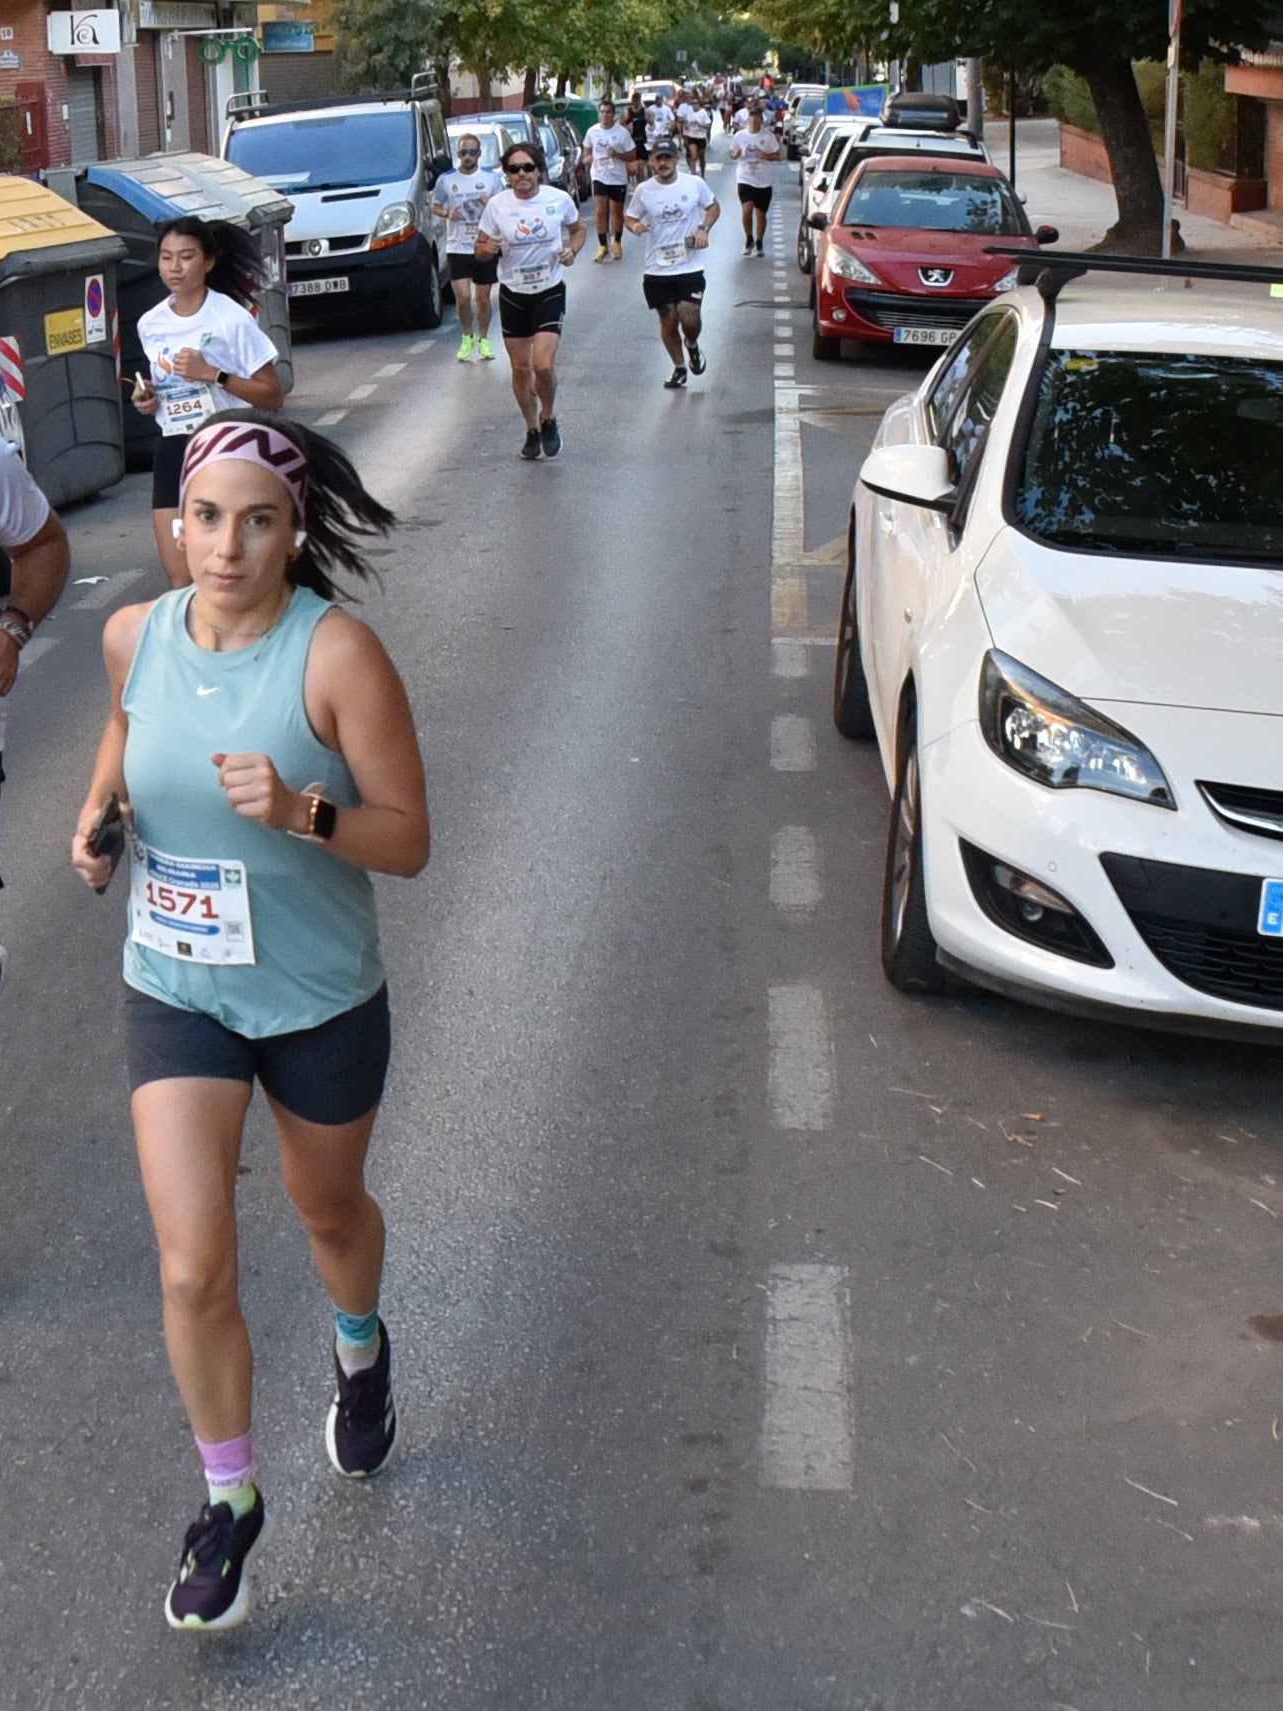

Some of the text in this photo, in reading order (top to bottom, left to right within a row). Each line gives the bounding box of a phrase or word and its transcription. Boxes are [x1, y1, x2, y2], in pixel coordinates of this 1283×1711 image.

[292, 282, 321, 294] 7388
[48, 328, 83, 350] ENVASES
[903, 329, 957, 343] 7696 GP
[166, 399, 203, 416] 1264
[146, 880, 220, 919] 1571
[1266, 912, 1279, 926] E
